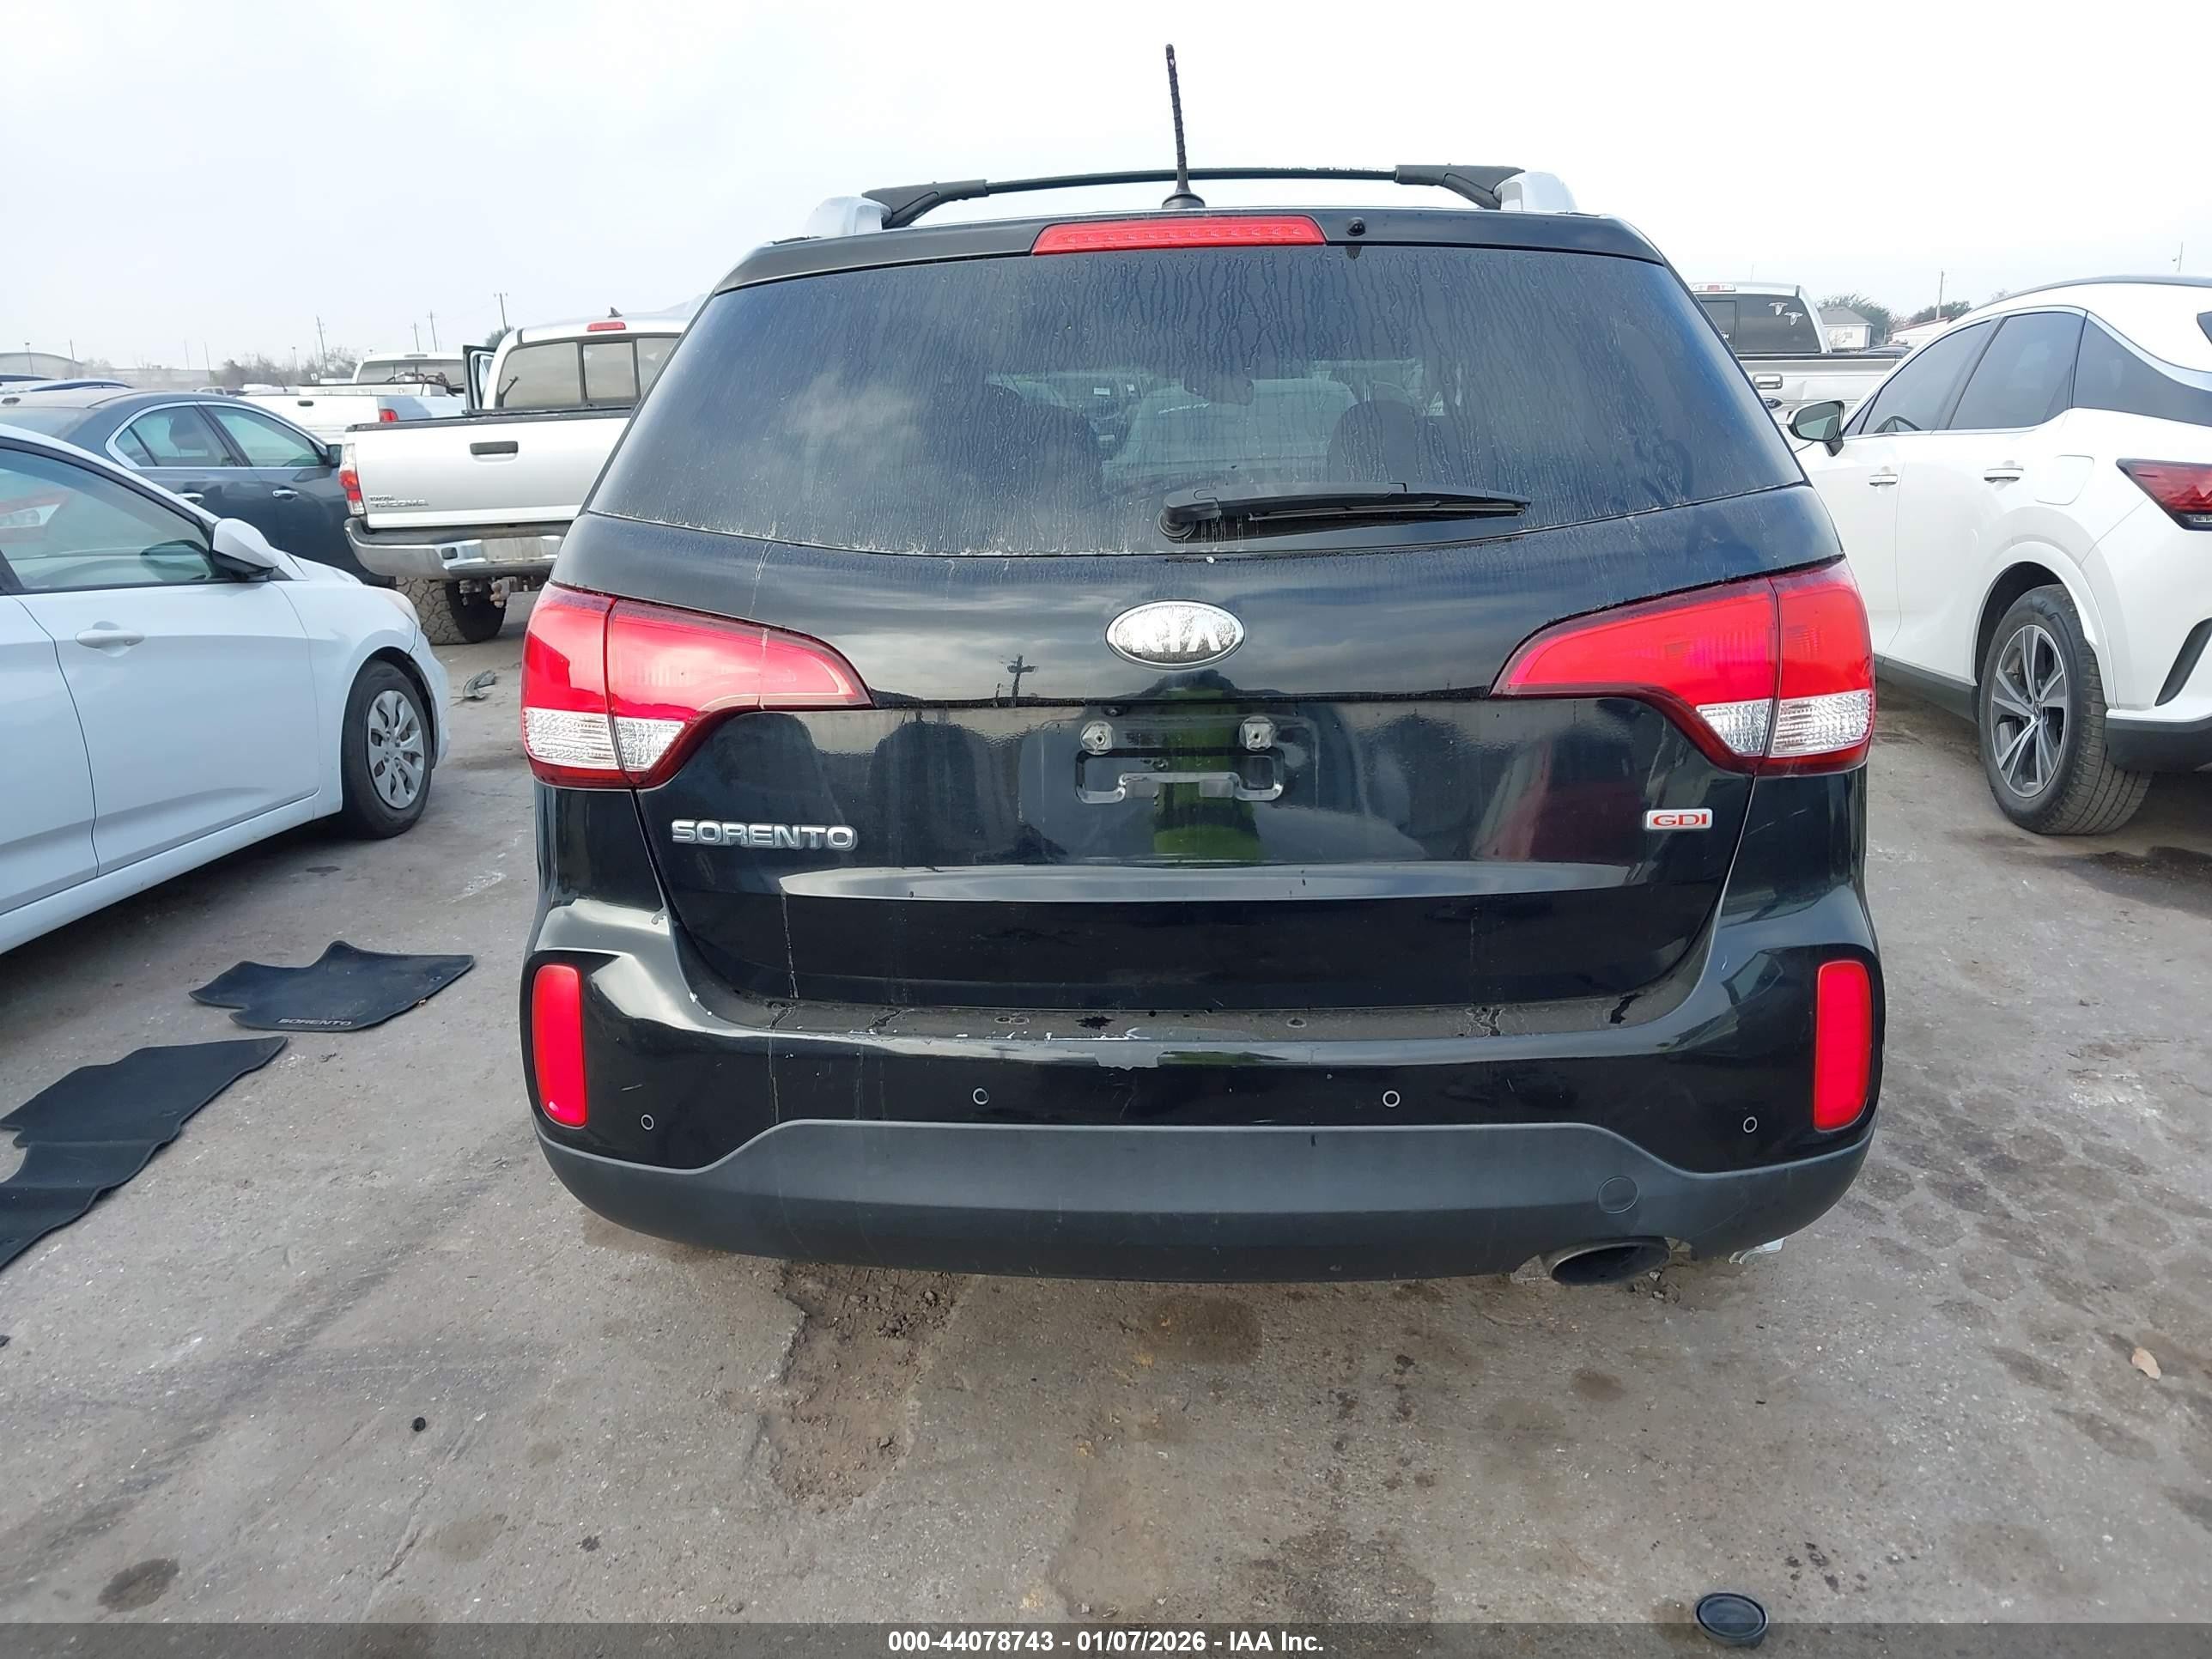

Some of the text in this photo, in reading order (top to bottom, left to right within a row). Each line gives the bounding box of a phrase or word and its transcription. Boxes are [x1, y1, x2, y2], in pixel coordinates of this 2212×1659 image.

[1130, 612, 1222, 653] KIA
[1653, 814, 1707, 826] GDI
[671, 819, 857, 851] SORENTO
[276, 1018, 353, 1026] SORENTO
